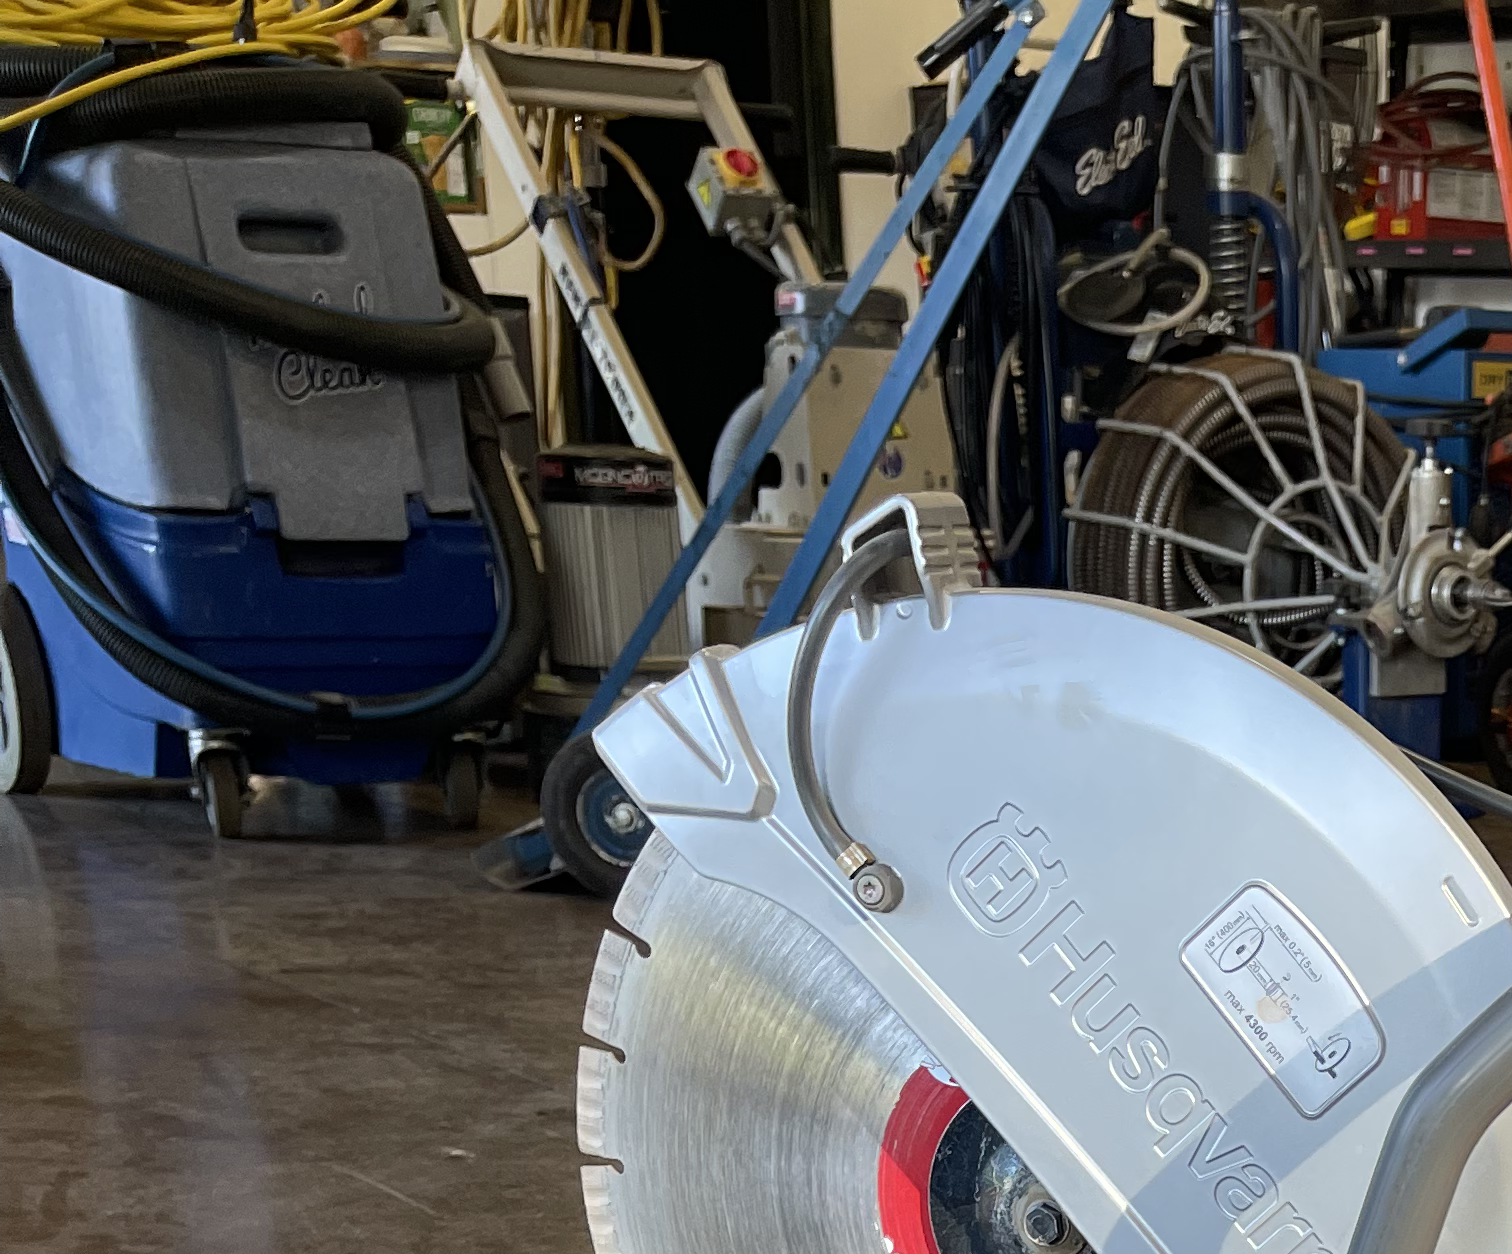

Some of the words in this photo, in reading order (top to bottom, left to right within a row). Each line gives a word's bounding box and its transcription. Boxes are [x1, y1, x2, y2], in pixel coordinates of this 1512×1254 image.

[1274, 924, 1290, 945] max
[1224, 990, 1245, 1015] max
[1245, 1013, 1268, 1042] 4300
[1265, 1040, 1285, 1065] rpm
